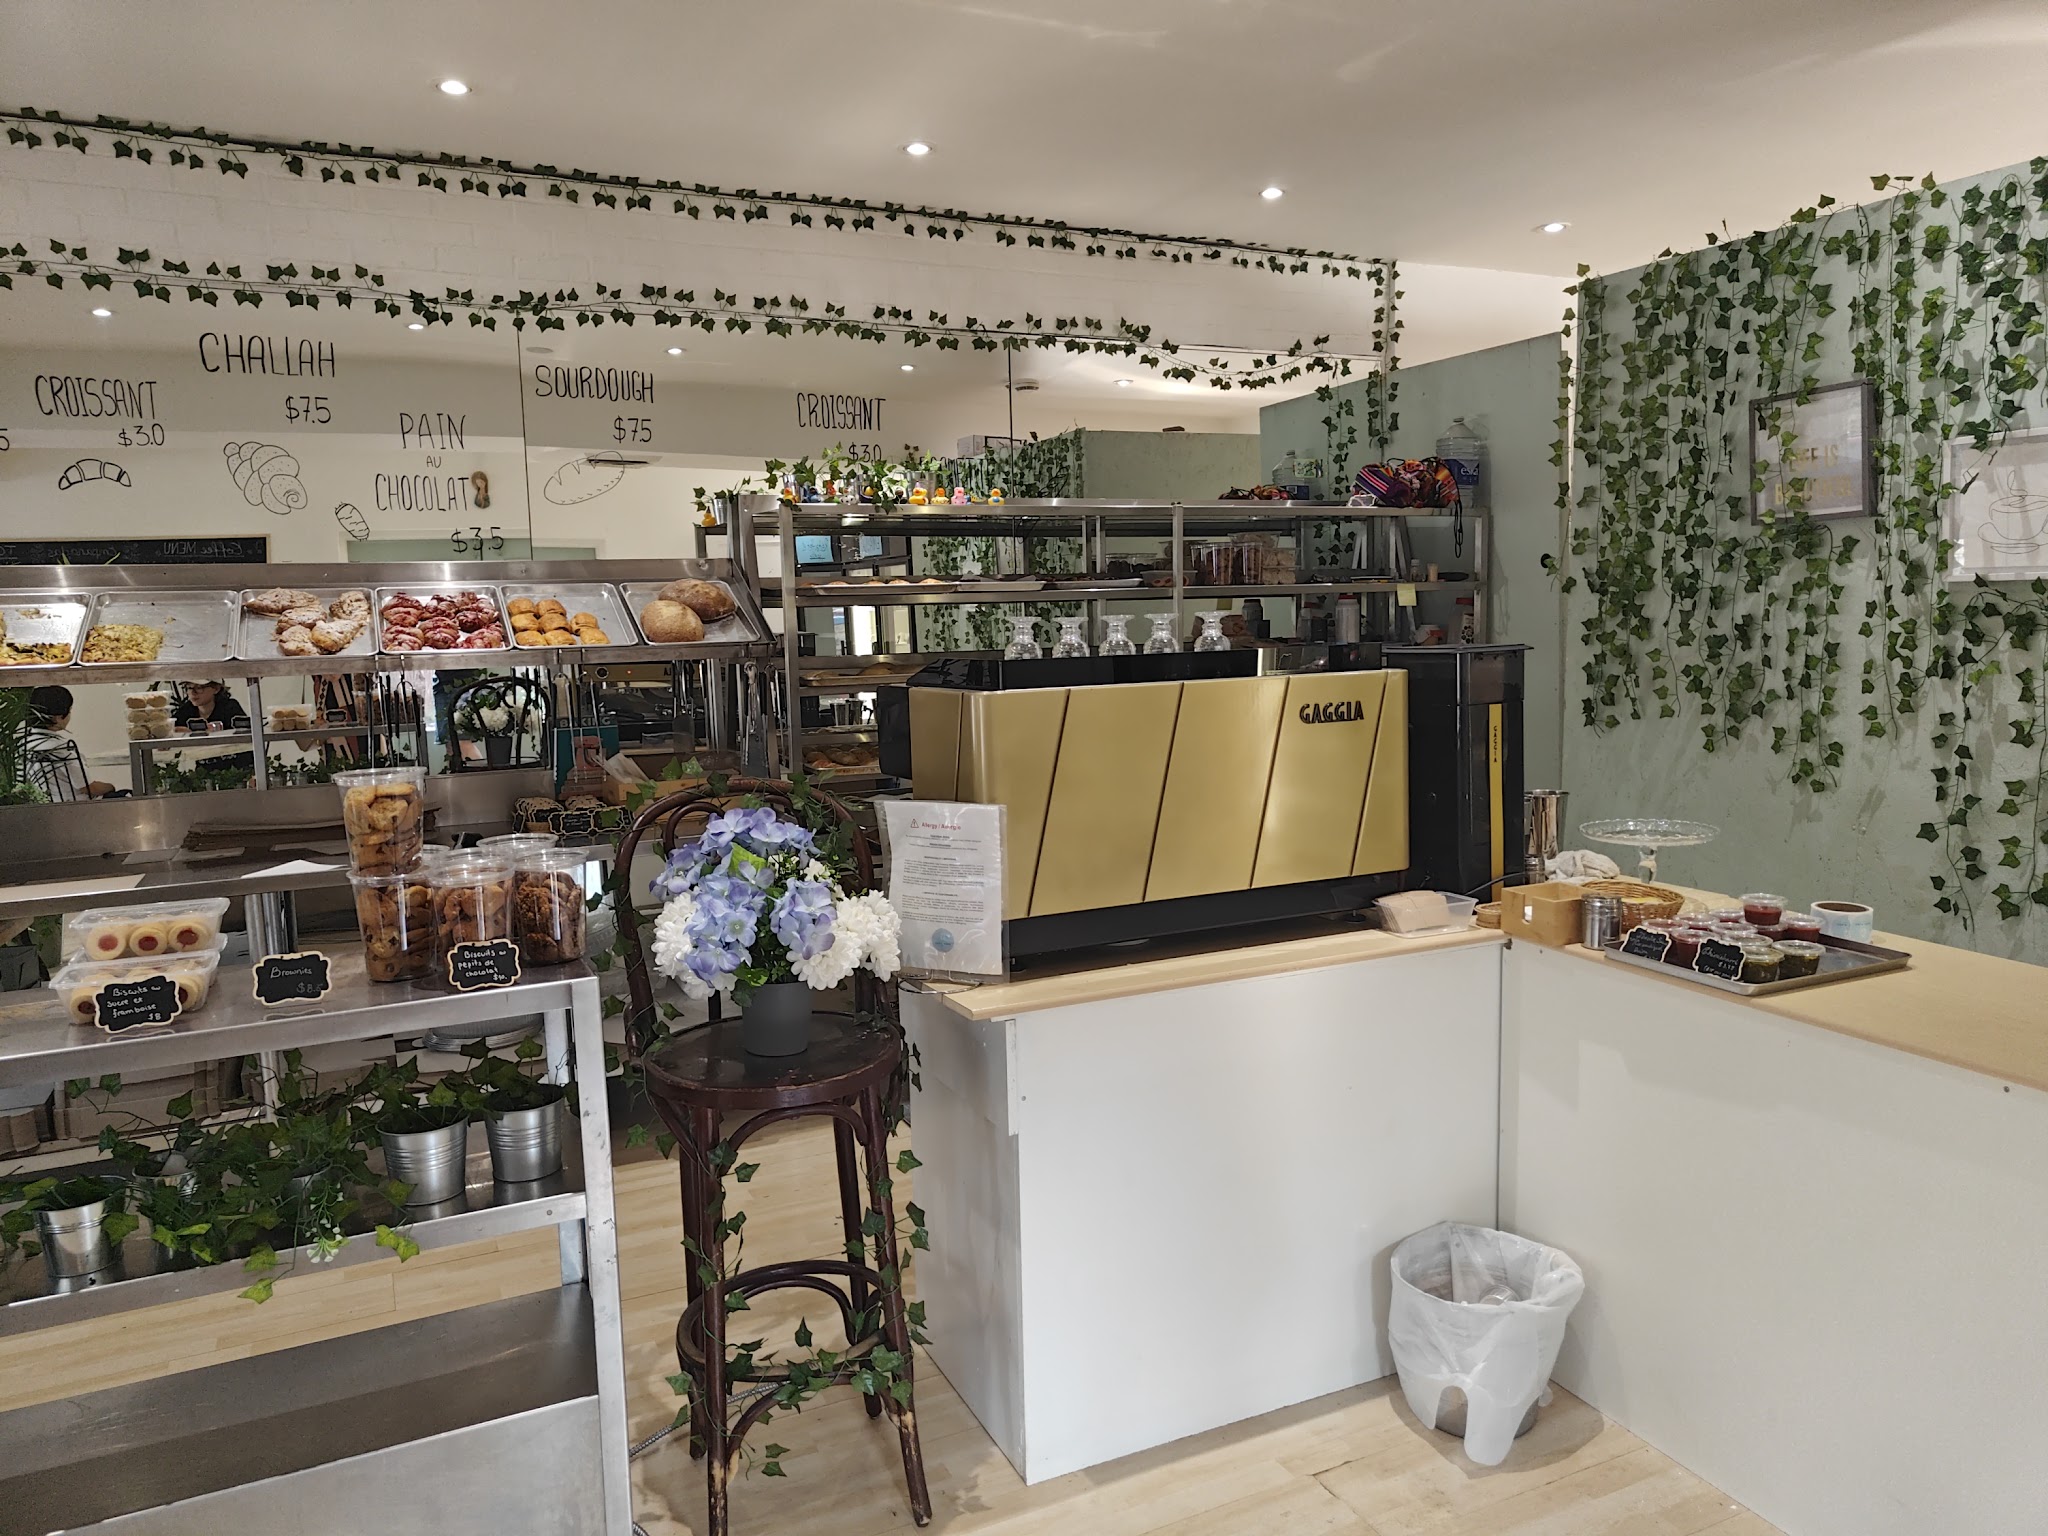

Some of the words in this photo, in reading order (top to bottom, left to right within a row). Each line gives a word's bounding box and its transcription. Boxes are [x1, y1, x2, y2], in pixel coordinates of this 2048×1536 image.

[199, 332, 336, 378] CHALLAH
[535, 364, 655, 404] SOURDOUGH
[35, 374, 157, 420] CROISSANT
[285, 395, 332, 424] $7.5
[797, 392, 887, 432] CROISSANT
[118, 423, 165, 447] $3.0
[400, 412, 467, 450] PAIN
[613, 415, 652, 443] $7.5
[426, 455, 442, 468] AU
[374, 473, 469, 512] CHOCOLAT
[451, 526, 504, 554] $3.5
[1299, 700, 1365, 724] GAGGIA
[921, 822, 938, 830] Allergy
[463, 948, 496, 959] Biscuits
[484, 959, 495, 967] de
[270, 966, 313, 979] Brownies
[465, 966, 499, 978] chocolat
[112, 986, 149, 997] Biscuits
[133, 996, 144, 1004] et
[112, 1003, 157, 1018] framboise
